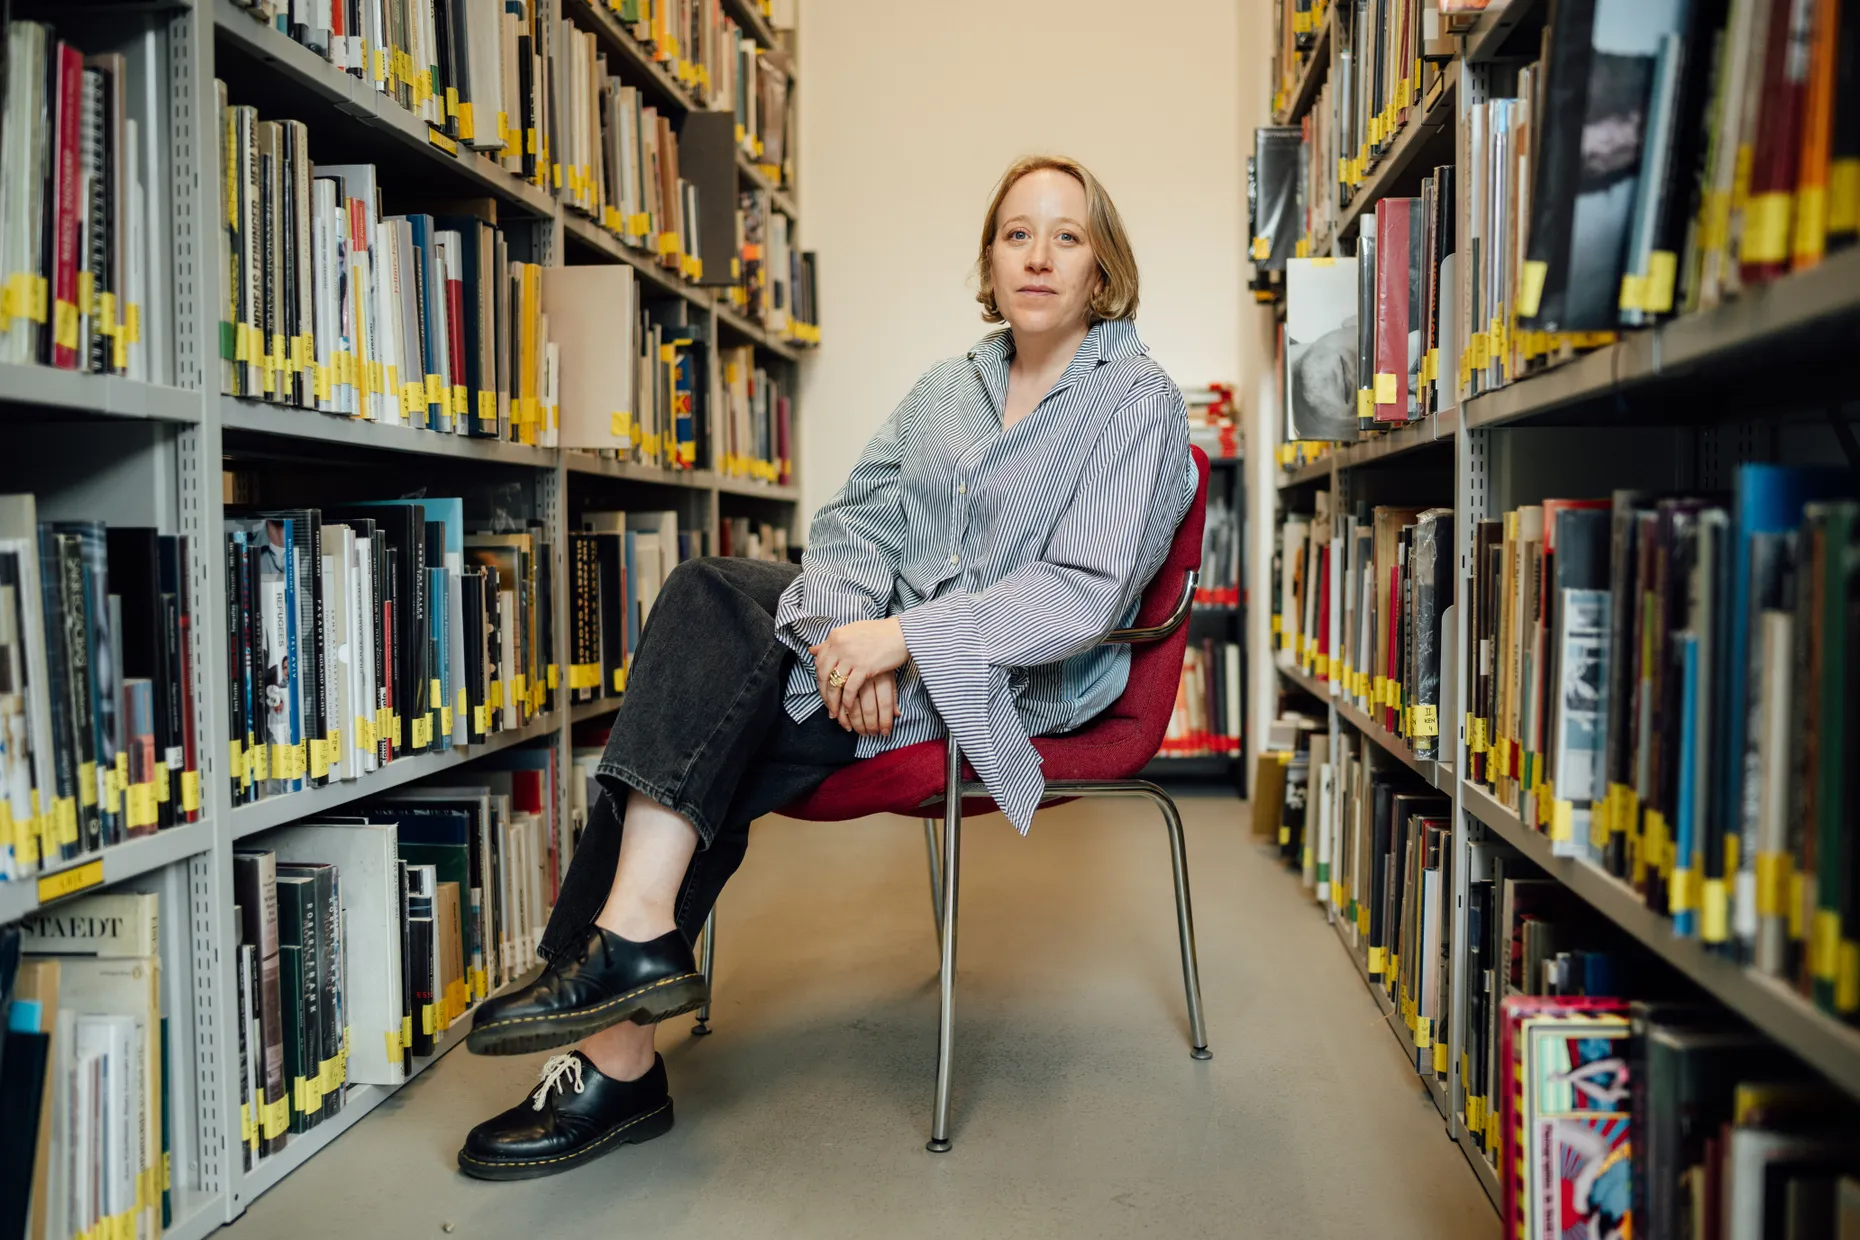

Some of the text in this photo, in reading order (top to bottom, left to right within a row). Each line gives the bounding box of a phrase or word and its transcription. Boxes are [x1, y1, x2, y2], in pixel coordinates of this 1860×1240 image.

[276, 592, 285, 647] REFUGEES
[1425, 707, 1432, 717] II
[306, 902, 317, 1014] ROBERT FRANK
